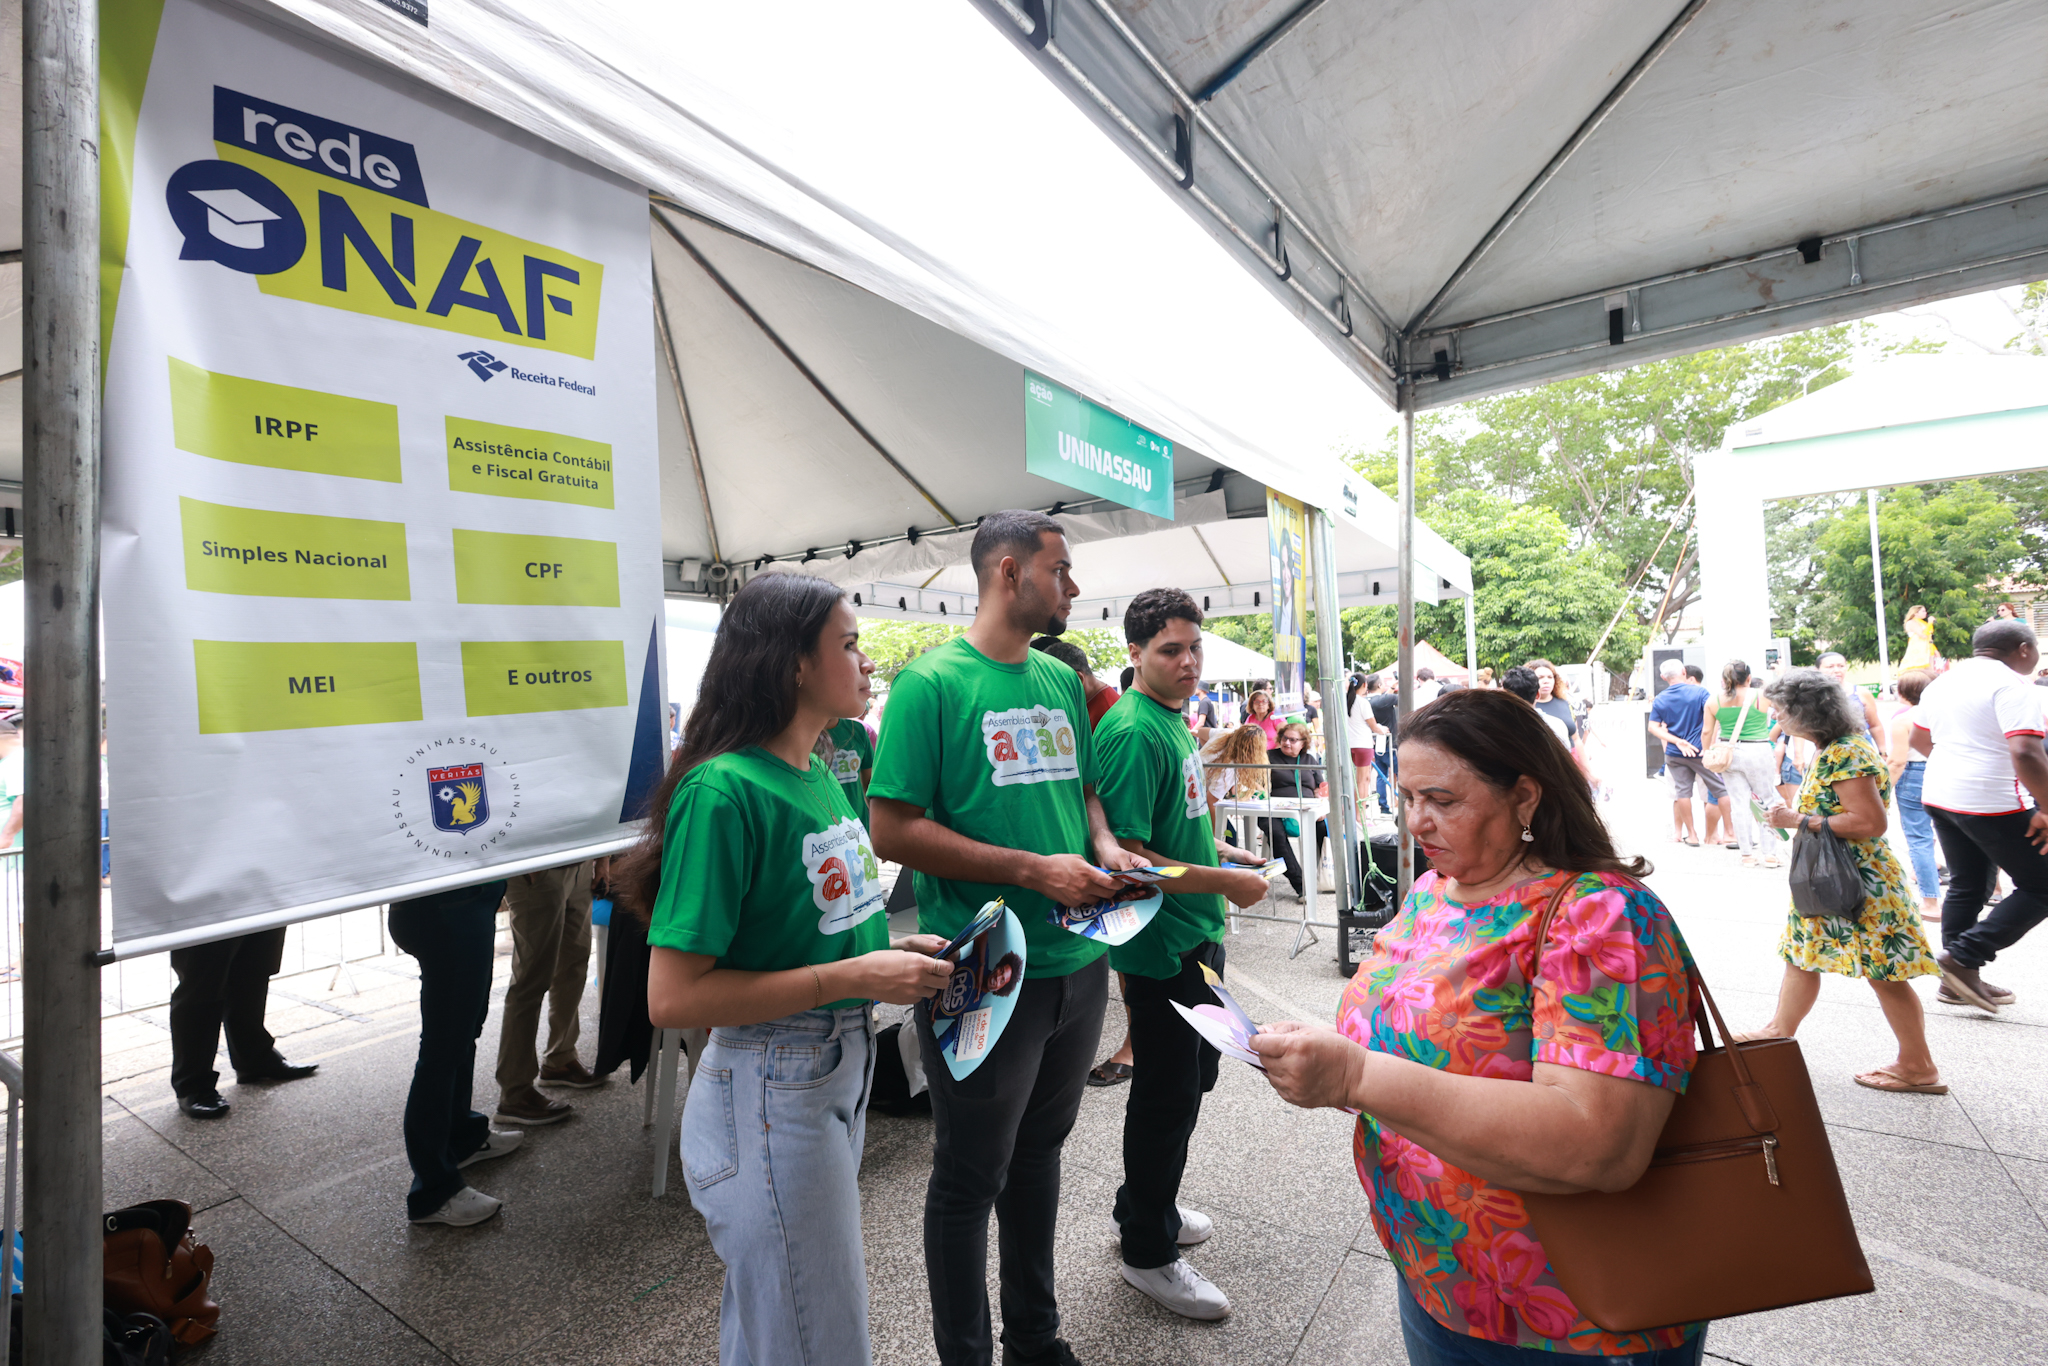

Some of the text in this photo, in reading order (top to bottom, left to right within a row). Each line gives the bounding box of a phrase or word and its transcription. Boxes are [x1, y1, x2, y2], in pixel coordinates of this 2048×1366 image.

[243, 106, 401, 189] rede
[511, 367, 596, 396] Receita Federal
[255, 415, 318, 441] IRPF
[453, 437, 611, 472] Assistência Contábil
[1058, 430, 1152, 492] UNINASSAU
[472, 463, 599, 490] e Fiscal Gratuita
[202, 540, 387, 569] Simples Nacional
[524, 562, 563, 579] CPF
[288, 675, 336, 694] MEI
[507, 667, 593, 686] E outros
[988, 715, 1030, 727] Assembleia
[406, 737, 498, 764] UNINASSAU
[432, 768, 481, 780] VERITAS
[392, 789, 452, 858] UNINASSAU
[481, 773, 520, 851] UNINASSAU
[951, 972, 968, 1009] PÓS
[980, 1020, 987, 1032] de
[977, 1034, 985, 1050] 100
